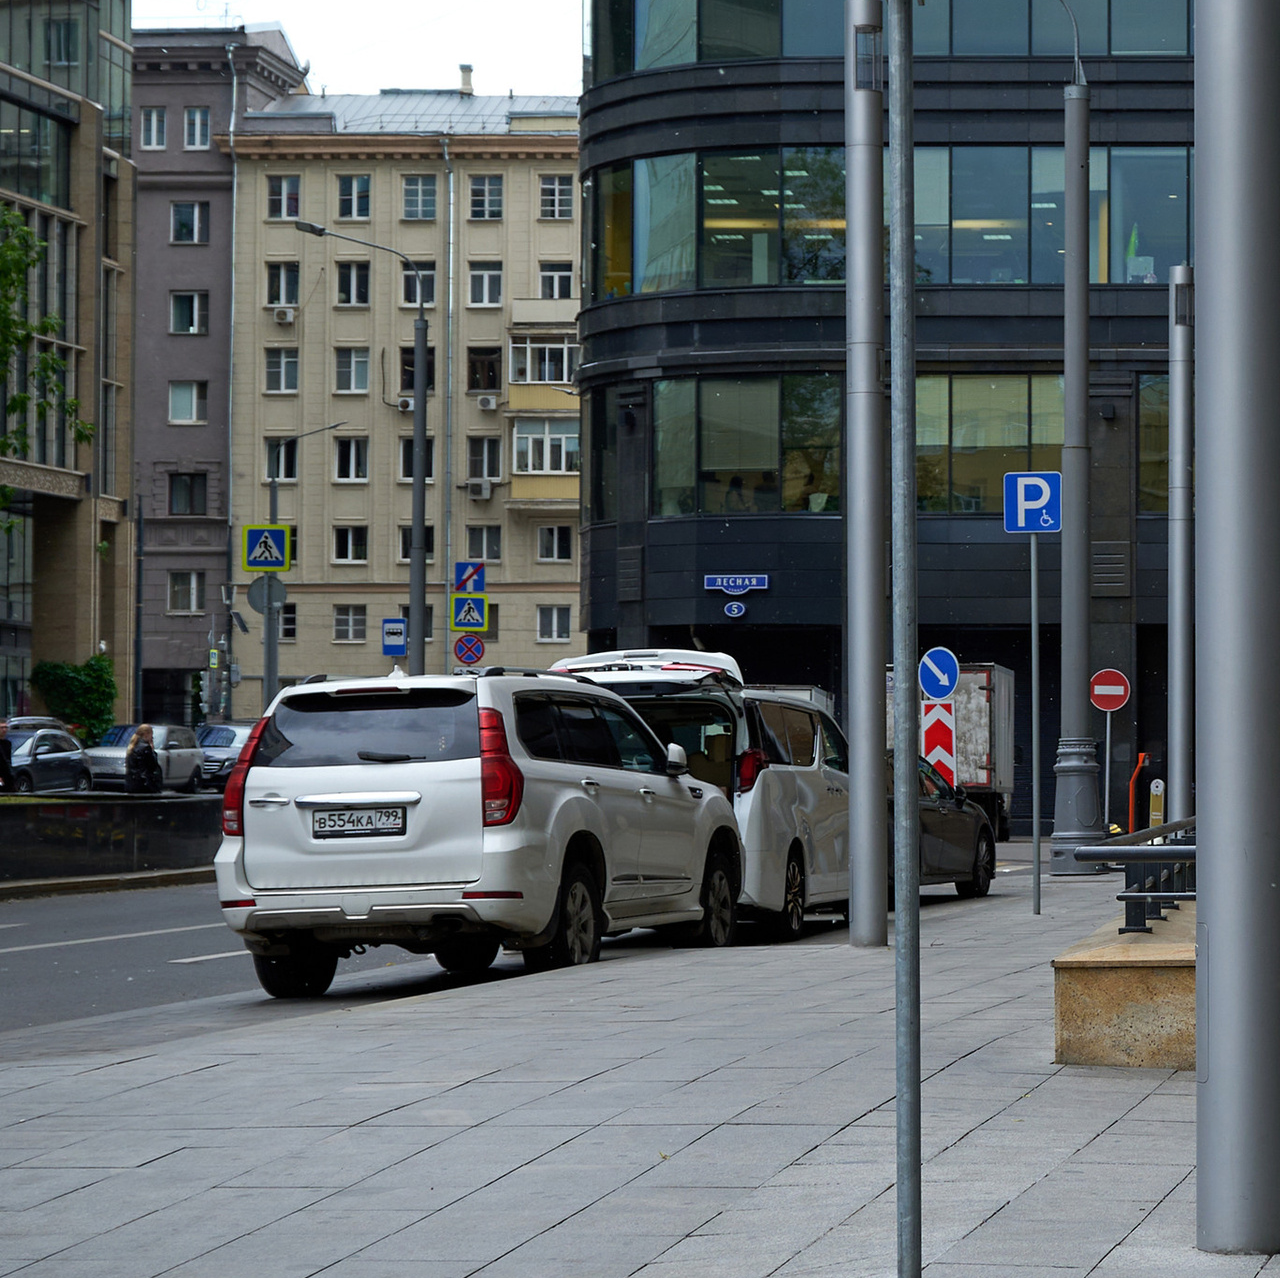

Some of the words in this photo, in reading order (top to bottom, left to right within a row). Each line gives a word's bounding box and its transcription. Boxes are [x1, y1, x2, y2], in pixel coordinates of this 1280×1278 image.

[1017, 476, 1051, 527] P
[715, 578, 757, 586] ЛЕСНАЯ
[731, 604, 738, 614] 5
[376, 810, 398, 822] 799
